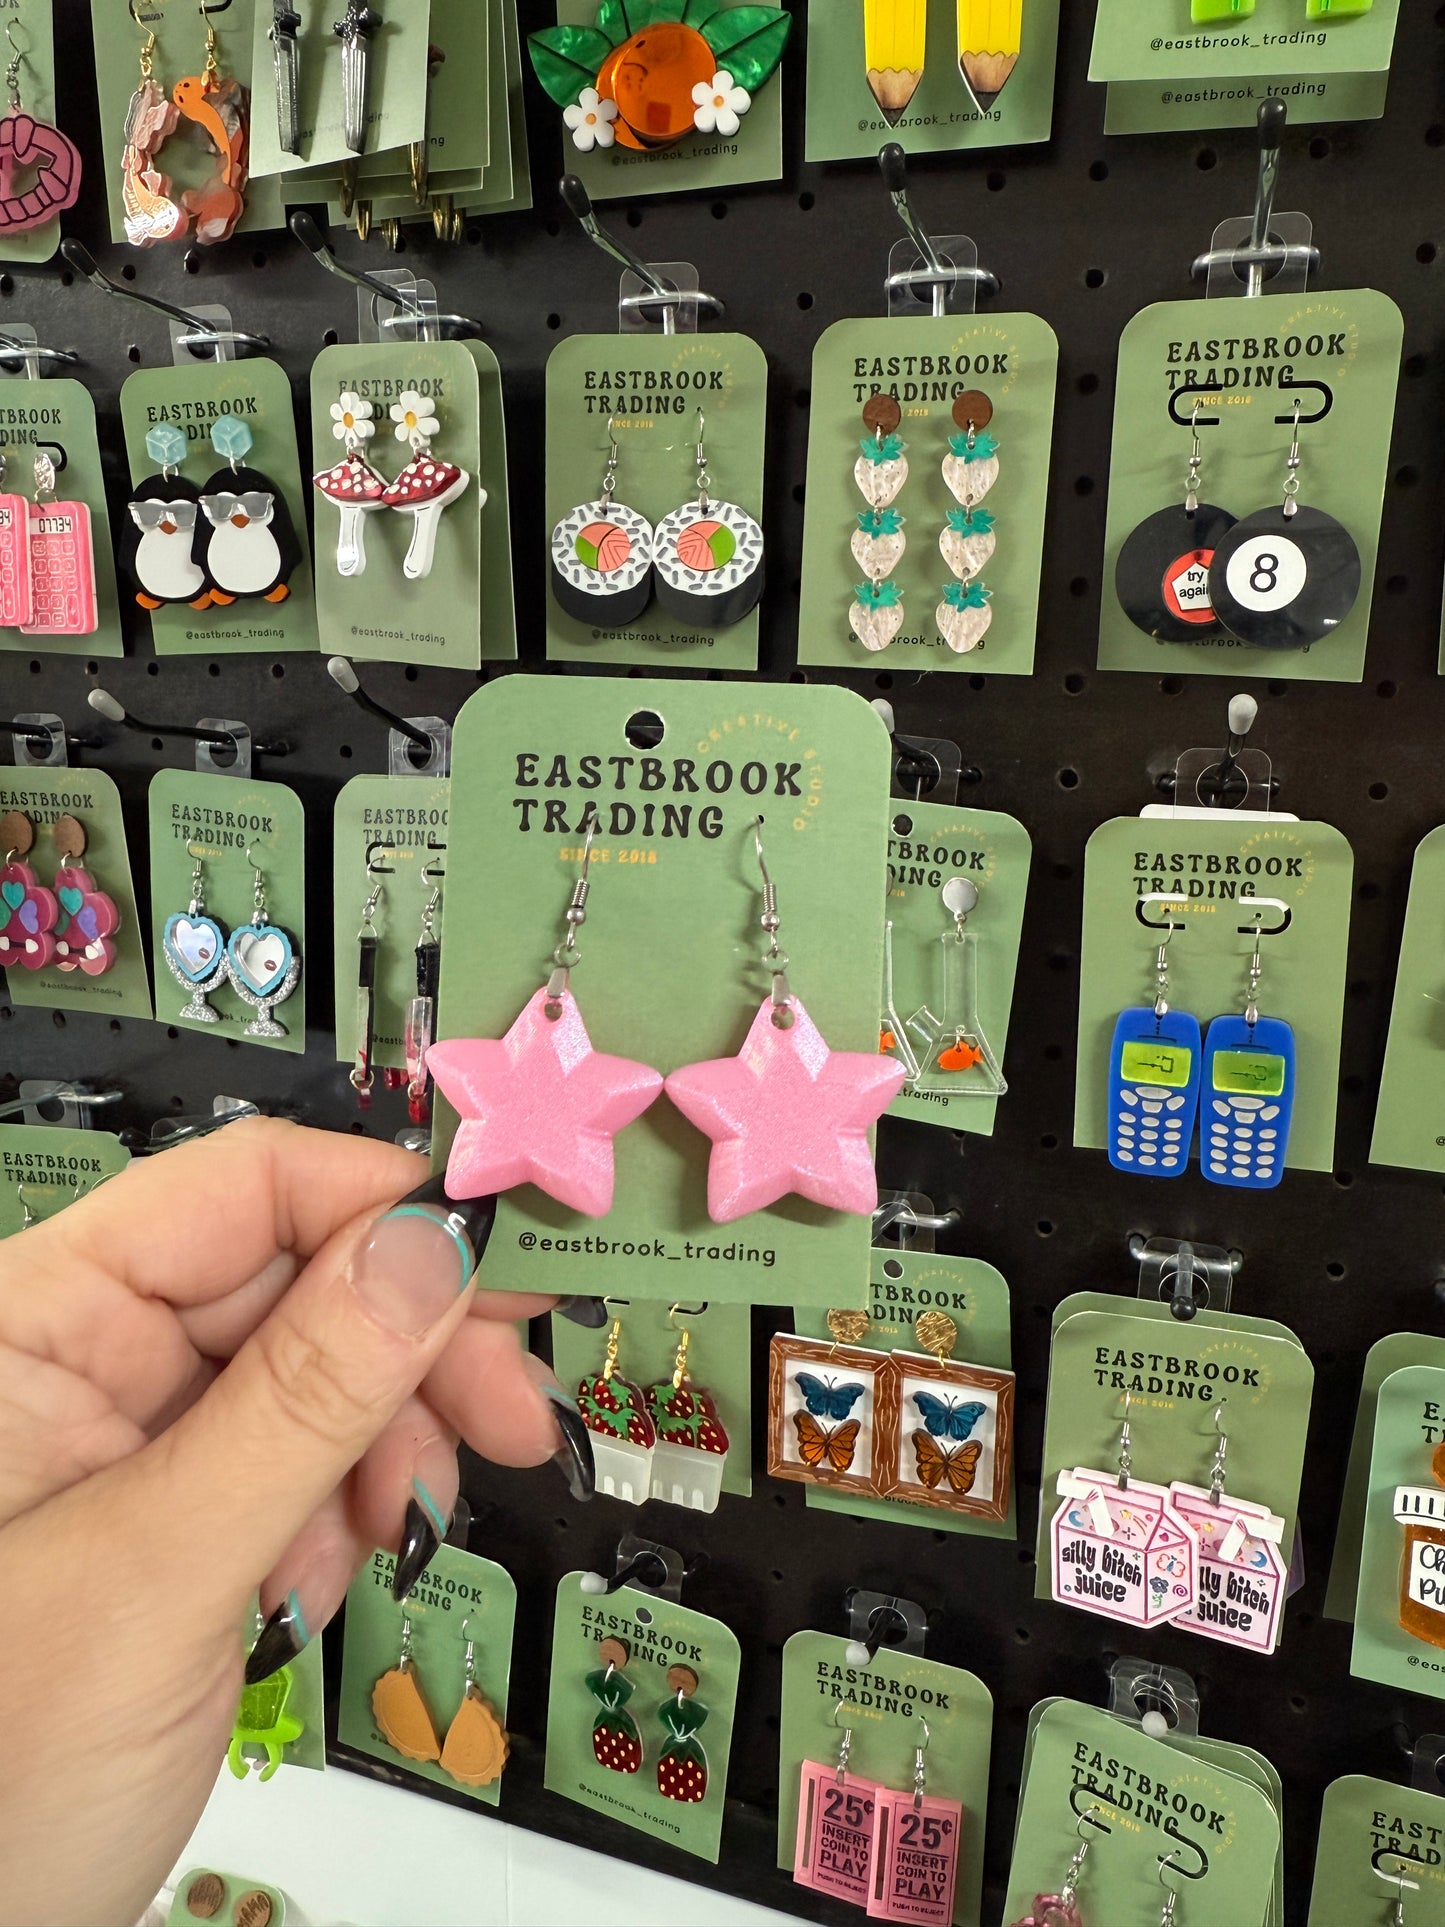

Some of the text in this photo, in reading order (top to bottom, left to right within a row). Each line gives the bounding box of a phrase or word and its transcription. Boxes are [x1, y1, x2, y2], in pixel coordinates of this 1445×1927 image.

[1150, 30, 1328, 52] @eastbrook_trading
[1161, 81, 1327, 105] @eastbrook_trading
[611, 143, 738, 166] @eastbrook_trading
[1167, 333, 1346, 363] EASTBROOK
[854, 354, 1008, 378] EASTBROOK
[1165, 365, 1294, 391] TRADING
[584, 371, 723, 390] EASTBROOK
[0, 408, 61, 424] TBROOK
[147, 397, 258, 422] EASTBROOK
[584, 395, 685, 414] TRADING
[39, 517, 72, 533] 07734
[1188, 571, 1204, 582] try
[1249, 553, 1279, 593] 8
[1179, 584, 1209, 599] agai
[592, 629, 714, 647] @eastbrook_trading
[515, 753, 803, 796] EASTBROOK
[0, 790, 93, 808] EASTBROOK
[172, 803, 272, 833] EASTBROOK
[512, 798, 724, 839] TRADING
[172, 823, 245, 848] TRADING
[363, 829, 437, 847] TRADING
[560, 847, 657, 864] SINCE 2018
[887, 839, 985, 871] TBROOK
[1134, 852, 1303, 877] EASTBROOK
[1133, 876, 1256, 899] TRADING
[3, 1151, 102, 1172] EASTBROOK
[5, 1168, 78, 1187] TRADING
[518, 1231, 776, 1268] @eastbrook_trading
[870, 1283, 967, 1309] TBROOK
[1095, 1346, 1260, 1387] EASTBROOK
[1094, 1368, 1213, 1402] TRADING
[1062, 1539, 1142, 1588] silly bitch
[372, 1570, 452, 1611] TRDING
[374, 1552, 483, 1605] EABROOK
[1074, 1567, 1127, 1603] juice
[1199, 1565, 1271, 1616] lly bitch
[1197, 1593, 1253, 1632] juice
[582, 1605, 702, 1662] EASTBROOK
[817, 1661, 949, 1709] EASTBROOK
[817, 1679, 913, 1717] TRADING
[1071, 1764, 1179, 1832] TRADING
[1074, 1741, 1226, 1834] EASTBROOK
[822, 1822, 870, 1849] INSERT
[821, 1837, 869, 1861] COIN TO
[896, 1850, 948, 1871] INSERT
[820, 1849, 867, 1878] PLAY
[896, 1864, 947, 1884] COIN TO
[895, 1878, 945, 1900] PLAY
